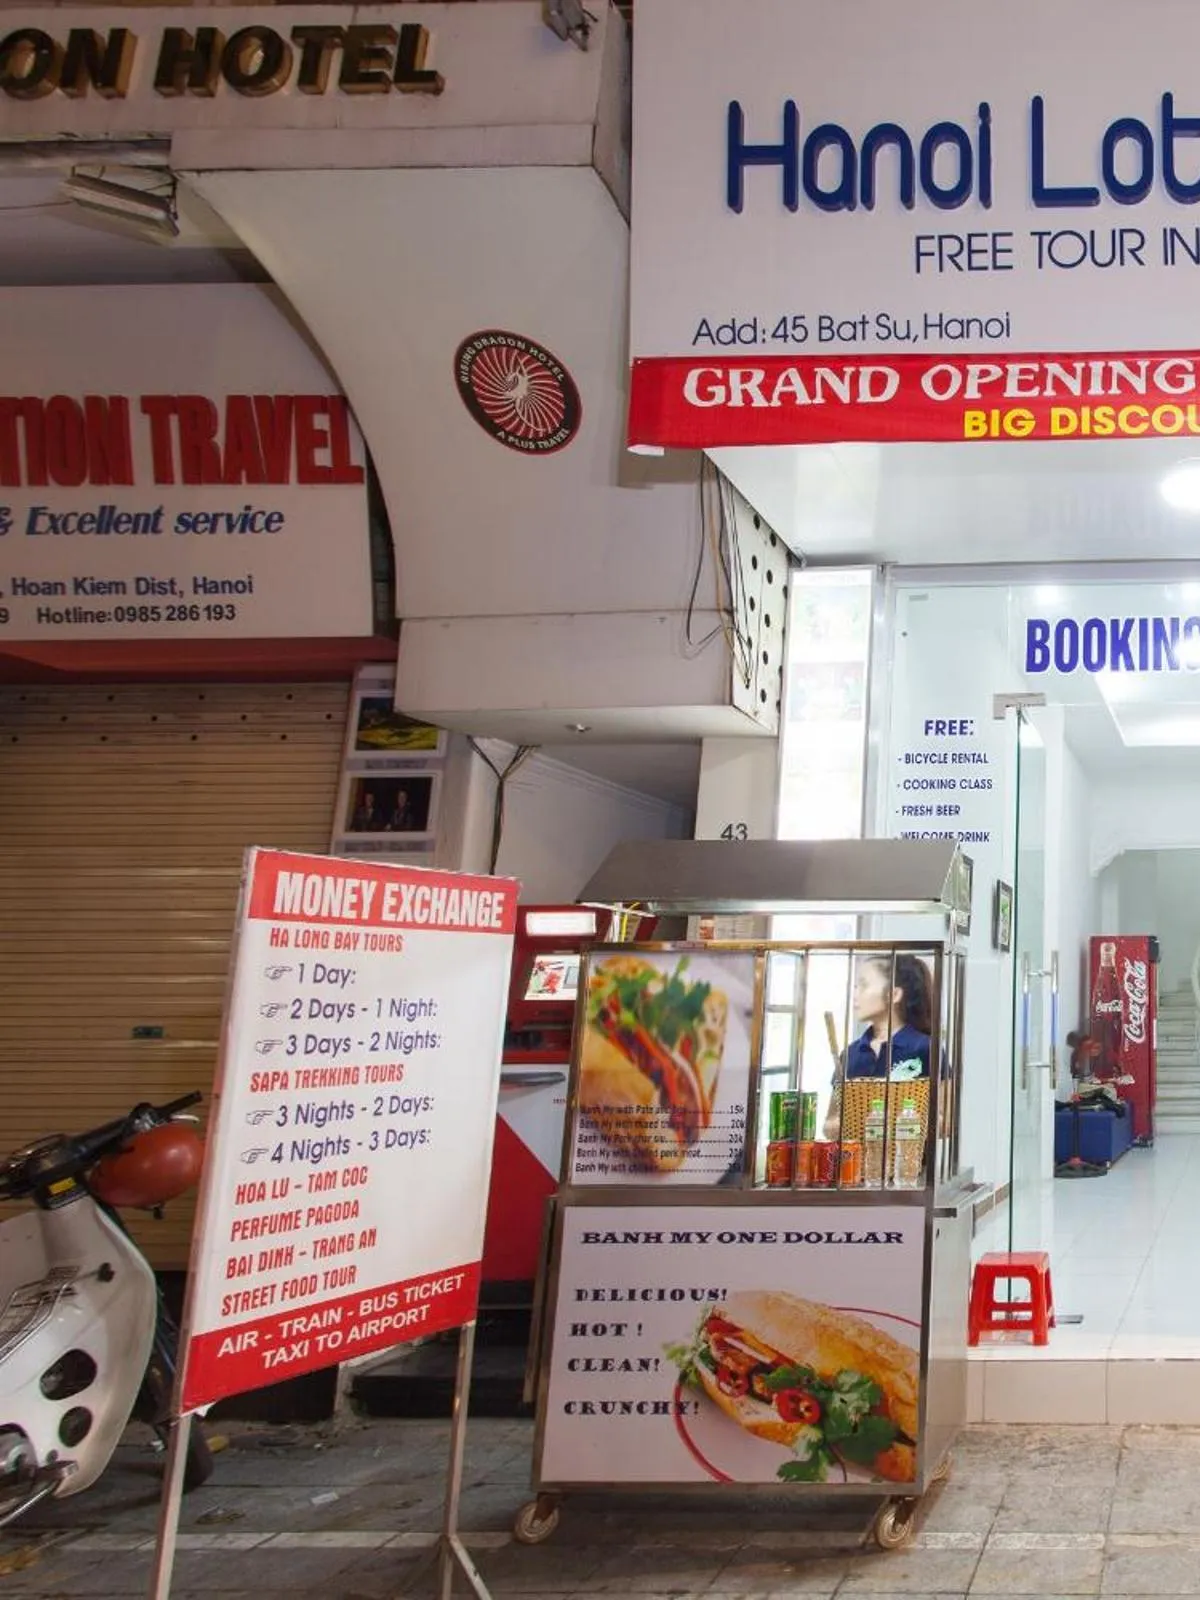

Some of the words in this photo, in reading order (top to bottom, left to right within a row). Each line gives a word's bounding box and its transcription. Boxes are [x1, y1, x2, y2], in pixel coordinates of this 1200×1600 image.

[153, 23, 446, 99] HOTEL
[727, 99, 993, 214] Hanoi
[914, 231, 1013, 273] FREE
[1031, 228, 1144, 269] TOUR
[818, 314, 869, 342] Bat
[473, 336, 526, 350] DRAGON
[529, 346, 565, 382] HOTEL
[683, 365, 900, 408] GRAND
[921, 357, 1197, 401] OPENING
[963, 408, 1037, 438] BIG
[140, 394, 365, 486] TRAVEL
[508, 437, 537, 449] PLUS
[26, 504, 165, 536] Excellent
[174, 504, 285, 536] service
[12, 577, 66, 597] Hoan
[73, 576, 127, 597] Kiem
[134, 576, 185, 599] Dist,
[193, 574, 254, 595] Hanoi
[166, 605, 200, 623] 286
[205, 604, 236, 622] 193
[923, 719, 975, 736] FREE:
[904, 753, 948, 764] BICYCLE
[951, 752, 989, 764] RENTAL
[903, 779, 957, 790] COOKING
[959, 779, 993, 790] CLASS
[901, 805, 933, 816] FRESH
[936, 805, 961, 816] BEER
[720, 823, 749, 841] 43
[957, 832, 990, 842] DRINK
[273, 871, 377, 921] MONEY
[382, 882, 505, 929] EXCHANGE
[270, 928, 289, 948] HA
[295, 928, 329, 950] LONG
[334, 930, 359, 951] BAY
[364, 931, 403, 952] TOURS
[299, 963, 305, 984] 1
[313, 964, 356, 988] Day:
[290, 999, 301, 1019] 2
[308, 999, 355, 1026] Days
[376, 998, 383, 1018] 1
[389, 997, 437, 1022] Night:
[286, 1034, 297, 1055] 3
[304, 1034, 351, 1059] Days
[369, 1032, 380, 1052] 2
[385, 1031, 441, 1056] Nights:
[250, 1070, 289, 1093] SAPA
[295, 1066, 360, 1090] TREKKING
[365, 1064, 404, 1085] TOURS
[276, 1104, 288, 1128] 3
[295, 1100, 355, 1128] Nights
[373, 1097, 384, 1117] 2
[388, 1094, 434, 1120] Days:
[270, 1144, 283, 1165] 4
[290, 1136, 351, 1165] Nights
[369, 1131, 380, 1151] 3
[384, 1128, 432, 1152] Days:
[235, 1182, 267, 1206] HOA
[271, 1177, 290, 1200] LU
[307, 1171, 338, 1194] TAM
[341, 1166, 369, 1188] COC
[230, 1209, 302, 1242] PERFUME
[305, 1199, 360, 1229] PAGODA
[581, 1231, 664, 1245] BANH
[670, 1231, 713, 1245] MY
[717, 1231, 778, 1244] ONE
[783, 1231, 904, 1245] DOLLAR
[226, 1255, 253, 1280] BAI
[257, 1244, 295, 1273] DINH
[312, 1233, 355, 1260] TRANG
[358, 1227, 378, 1249] AN
[221, 1283, 277, 1317] STREET
[281, 1272, 317, 1302] FOOD
[323, 1265, 357, 1292] TOUR
[575, 1288, 728, 1302] DELICIOUS!
[217, 1330, 258, 1358] AIR
[279, 1307, 342, 1339] TRAIN
[359, 1292, 399, 1317] BUS
[404, 1273, 465, 1304] TICKET
[570, 1323, 629, 1337] HOT
[261, 1340, 309, 1370] TAXI
[315, 1329, 341, 1351] TO
[347, 1304, 431, 1343] AIRPORT
[567, 1358, 661, 1372] CLEAN!
[564, 1401, 700, 1416] CRUNCHY!
